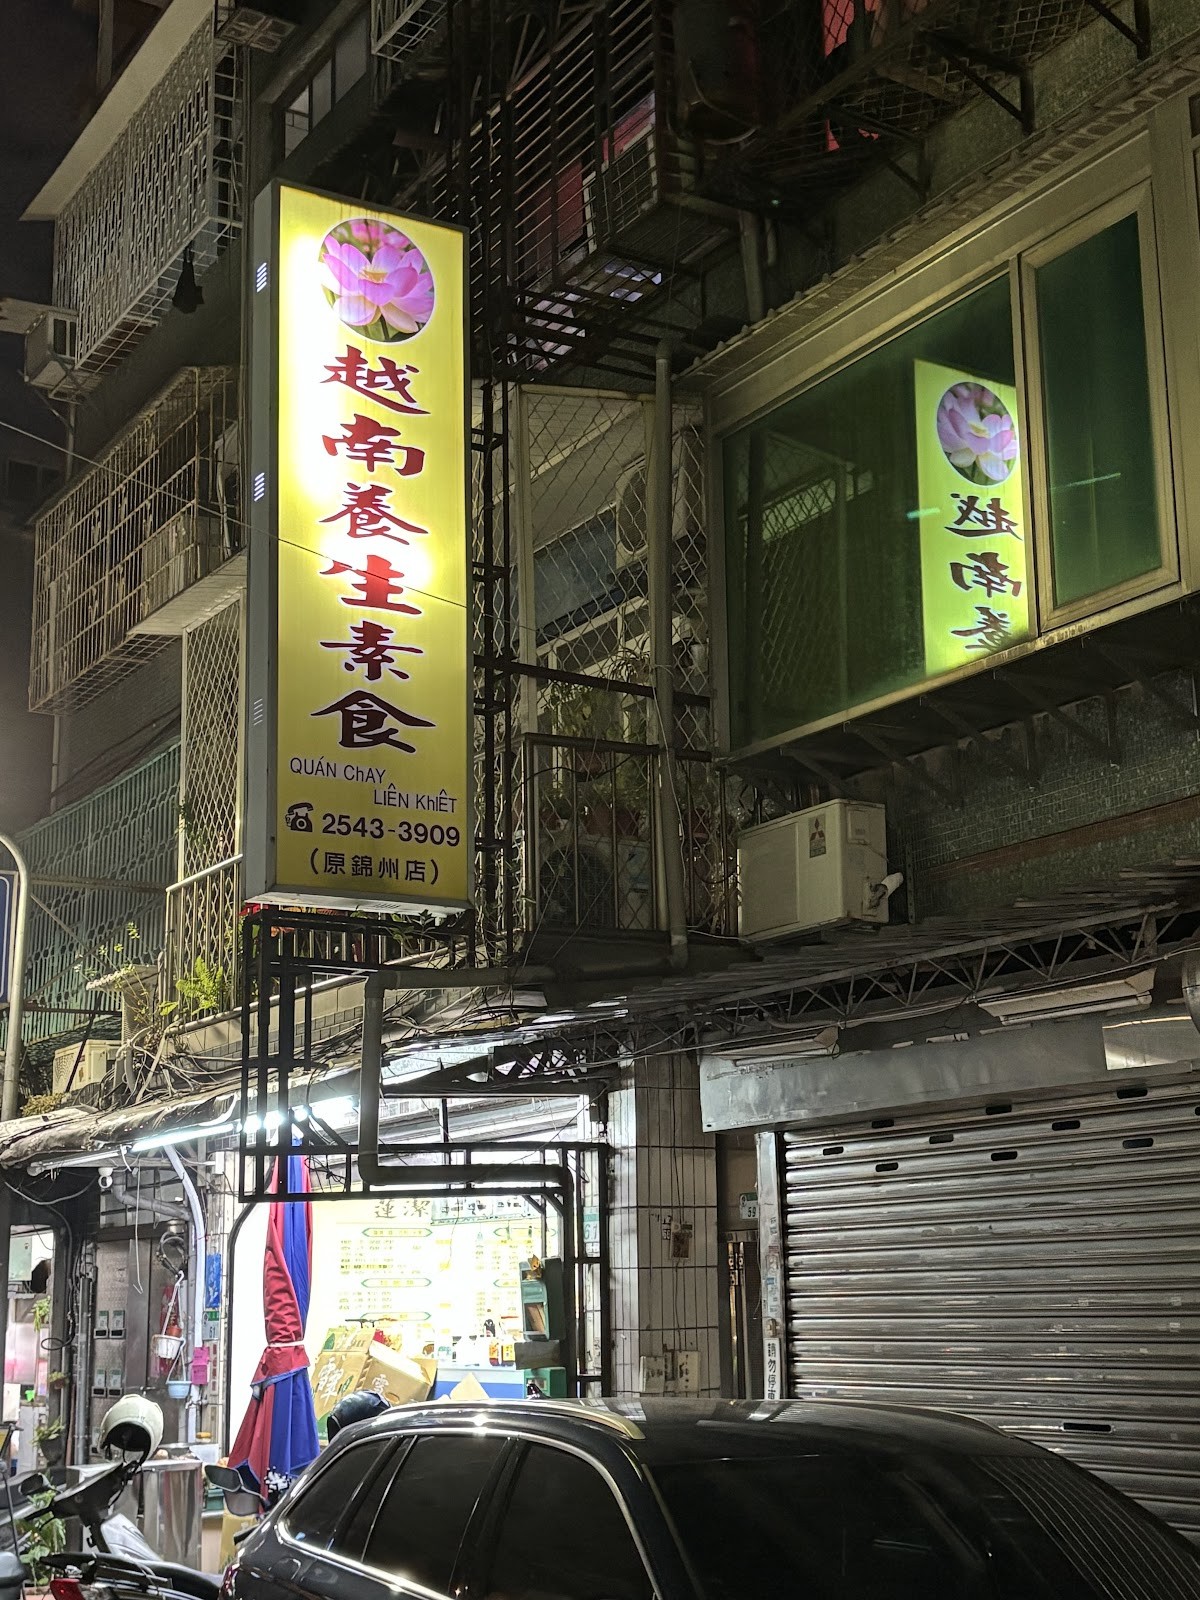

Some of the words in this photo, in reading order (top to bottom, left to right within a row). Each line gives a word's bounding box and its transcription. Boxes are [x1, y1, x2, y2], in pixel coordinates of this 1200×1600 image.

[311, 344, 437, 754] 越南養生素食
[289, 755, 337, 779] QUÁN
[373, 782, 410, 810] LIÊN
[321, 812, 460, 847] 2543-3909
[309, 847, 440, 886] (原錦州店)
